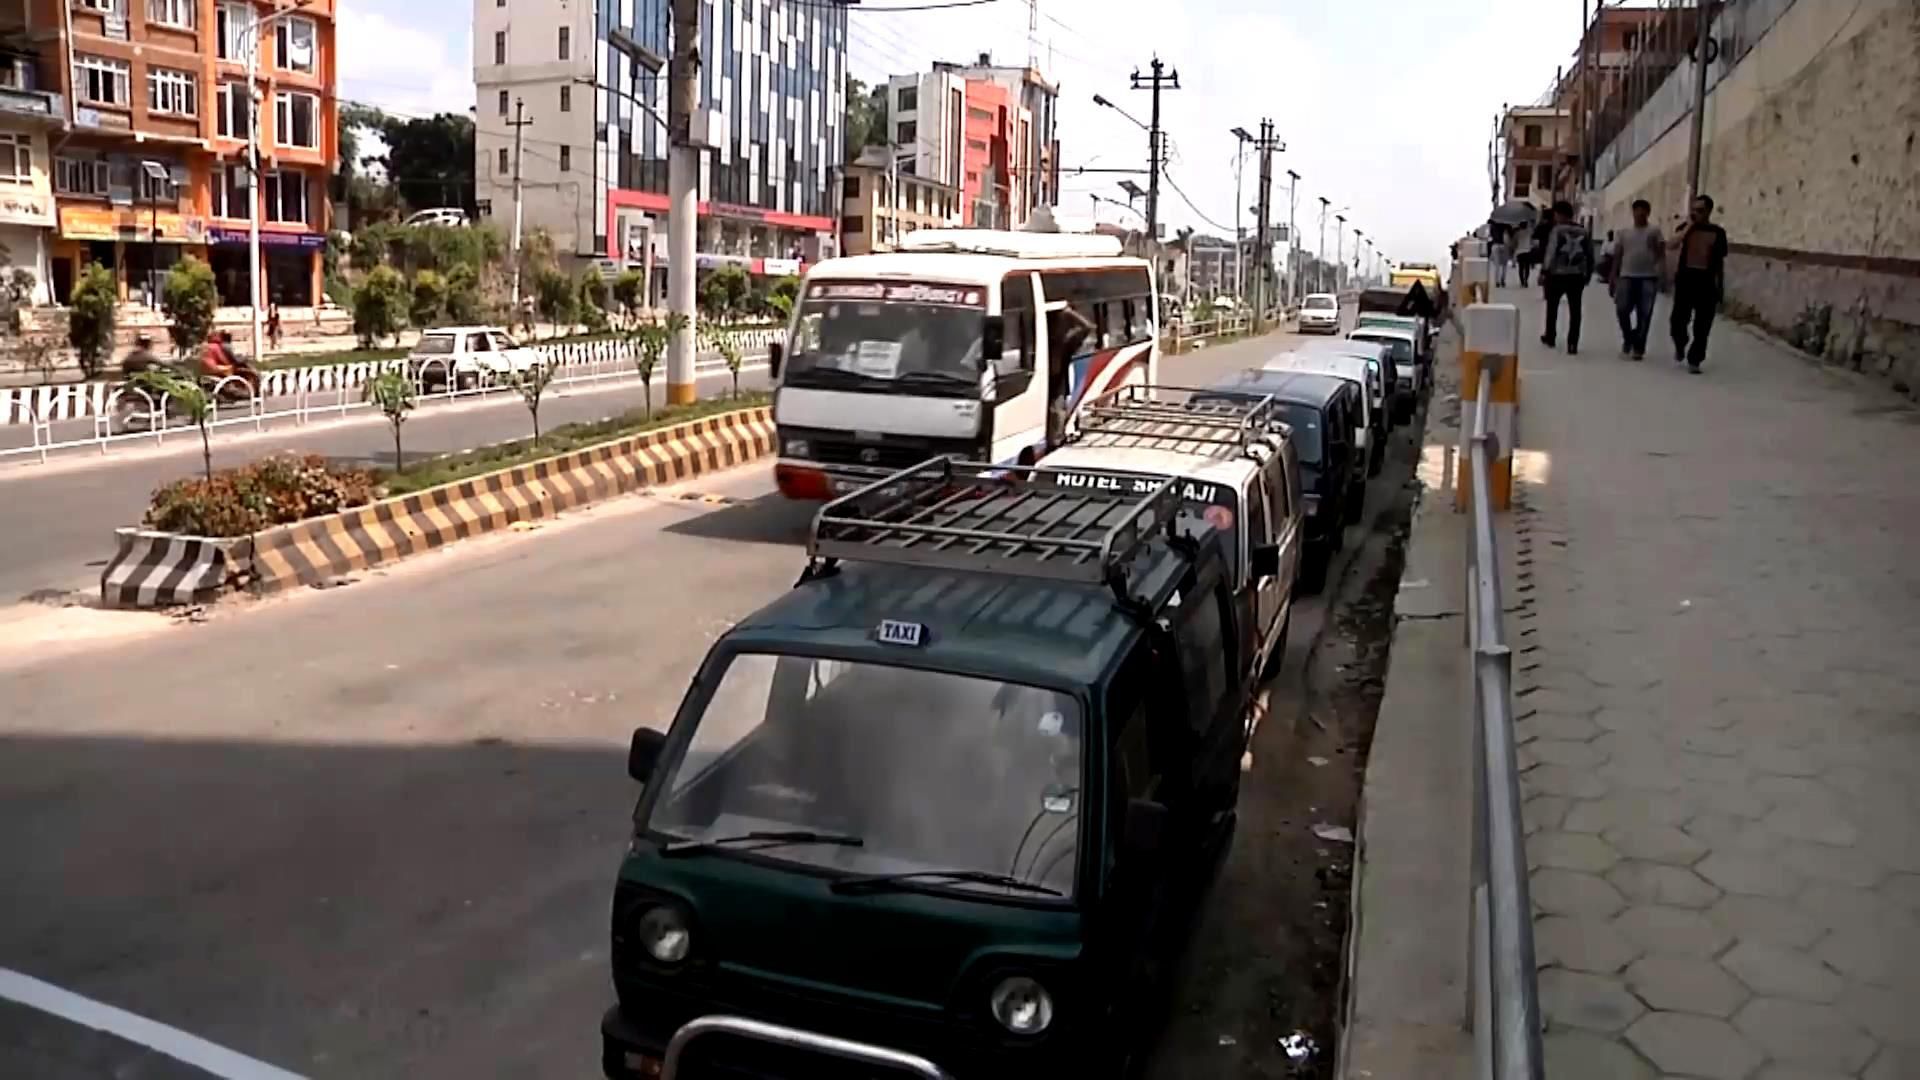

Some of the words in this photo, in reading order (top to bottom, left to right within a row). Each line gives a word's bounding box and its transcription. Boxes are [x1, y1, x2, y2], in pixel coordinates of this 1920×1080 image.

[1056, 472, 1121, 490] HOTEL
[1132, 479, 1217, 503] SHAJI
[884, 623, 916, 640] TAXI
